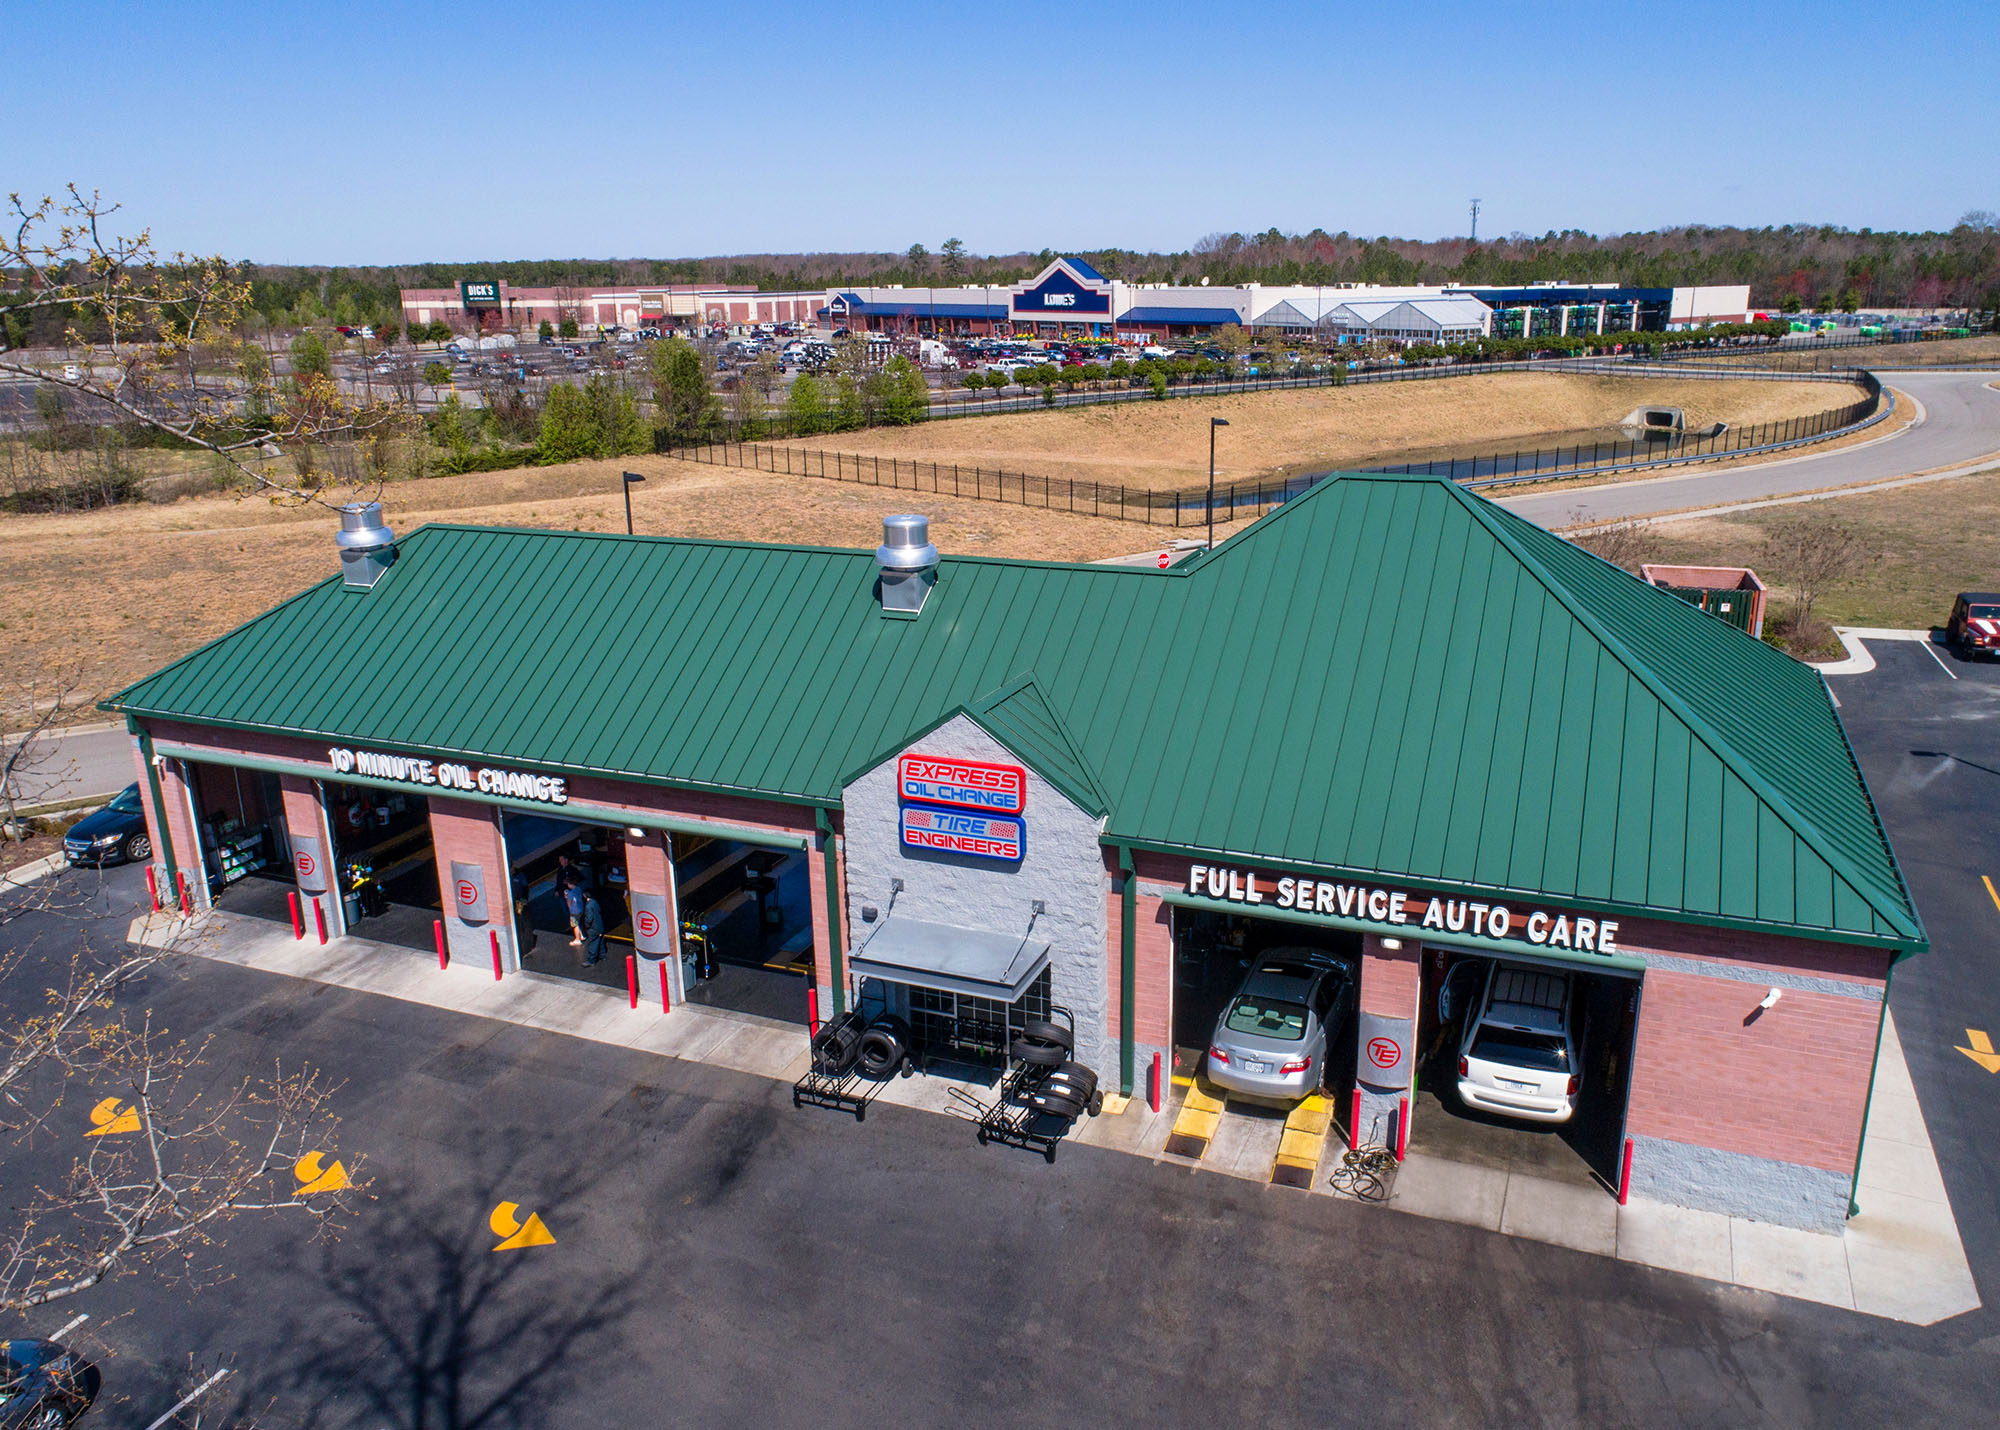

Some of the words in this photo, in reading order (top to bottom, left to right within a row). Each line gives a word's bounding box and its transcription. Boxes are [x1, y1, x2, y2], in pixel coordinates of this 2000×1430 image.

[467, 284, 494, 296] DICK'S
[328, 747, 354, 772] 10
[356, 751, 436, 784] MINUTE
[438, 763, 476, 790] OIL
[477, 768, 568, 803] CHANGE
[905, 761, 1018, 789] EXPRESS
[905, 782, 935, 798] OIL
[938, 786, 1017, 808] CHANGE
[934, 814, 987, 835] TIRE
[905, 829, 1018, 858] ENGINEERS
[1190, 864, 1263, 903] FULL
[1277, 877, 1408, 923] SERVICE
[1422, 897, 1510, 937] AUTO
[1527, 911, 1618, 954] CARE
[1371, 1042, 1397, 1063] TE
